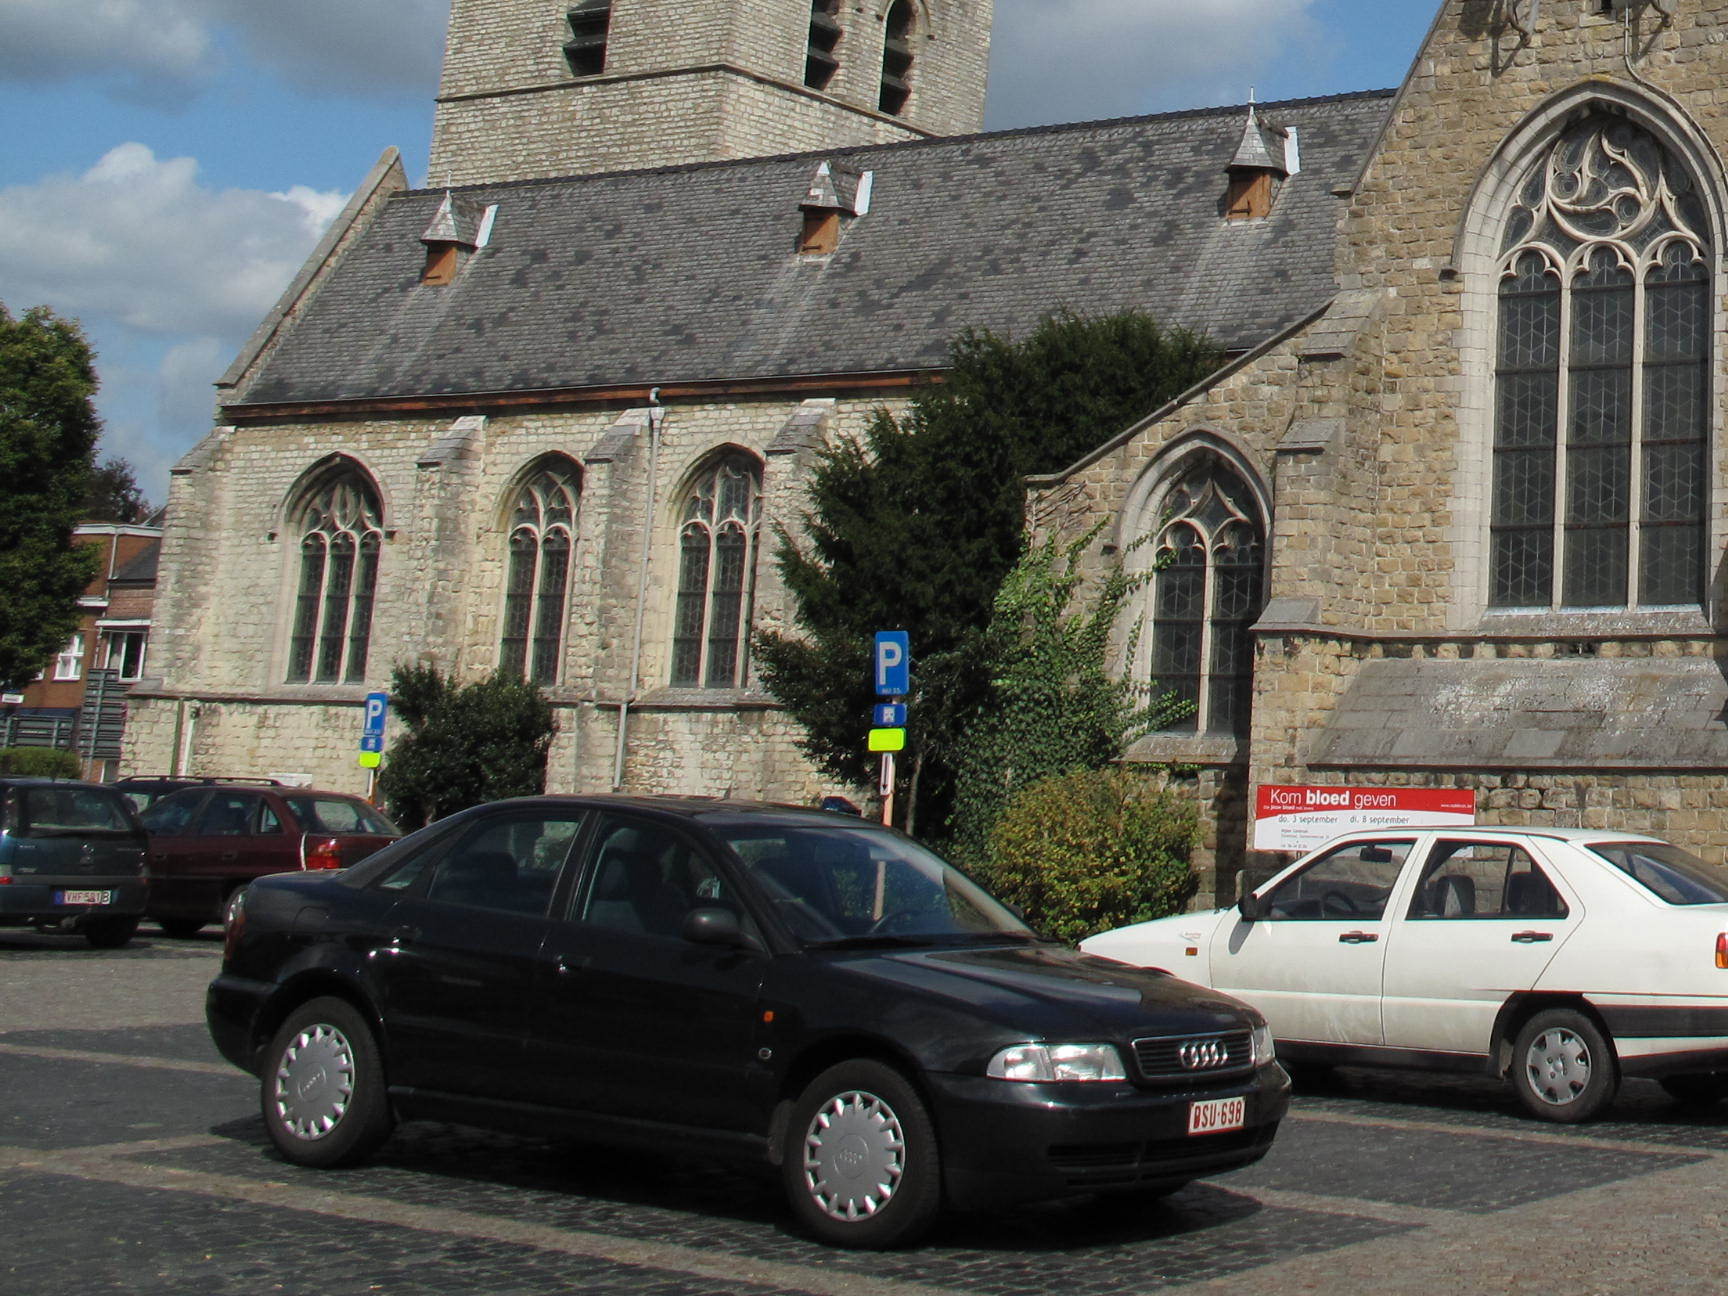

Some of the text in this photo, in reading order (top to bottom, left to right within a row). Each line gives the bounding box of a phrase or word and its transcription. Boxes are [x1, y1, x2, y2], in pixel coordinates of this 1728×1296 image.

[879, 641, 902, 686] P
[366, 699, 383, 730] P
[1270, 789, 1397, 809] Kom bloed geven
[1299, 815, 1338, 825] september
[1362, 816, 1367, 824] 8
[1369, 816, 1410, 825] september
